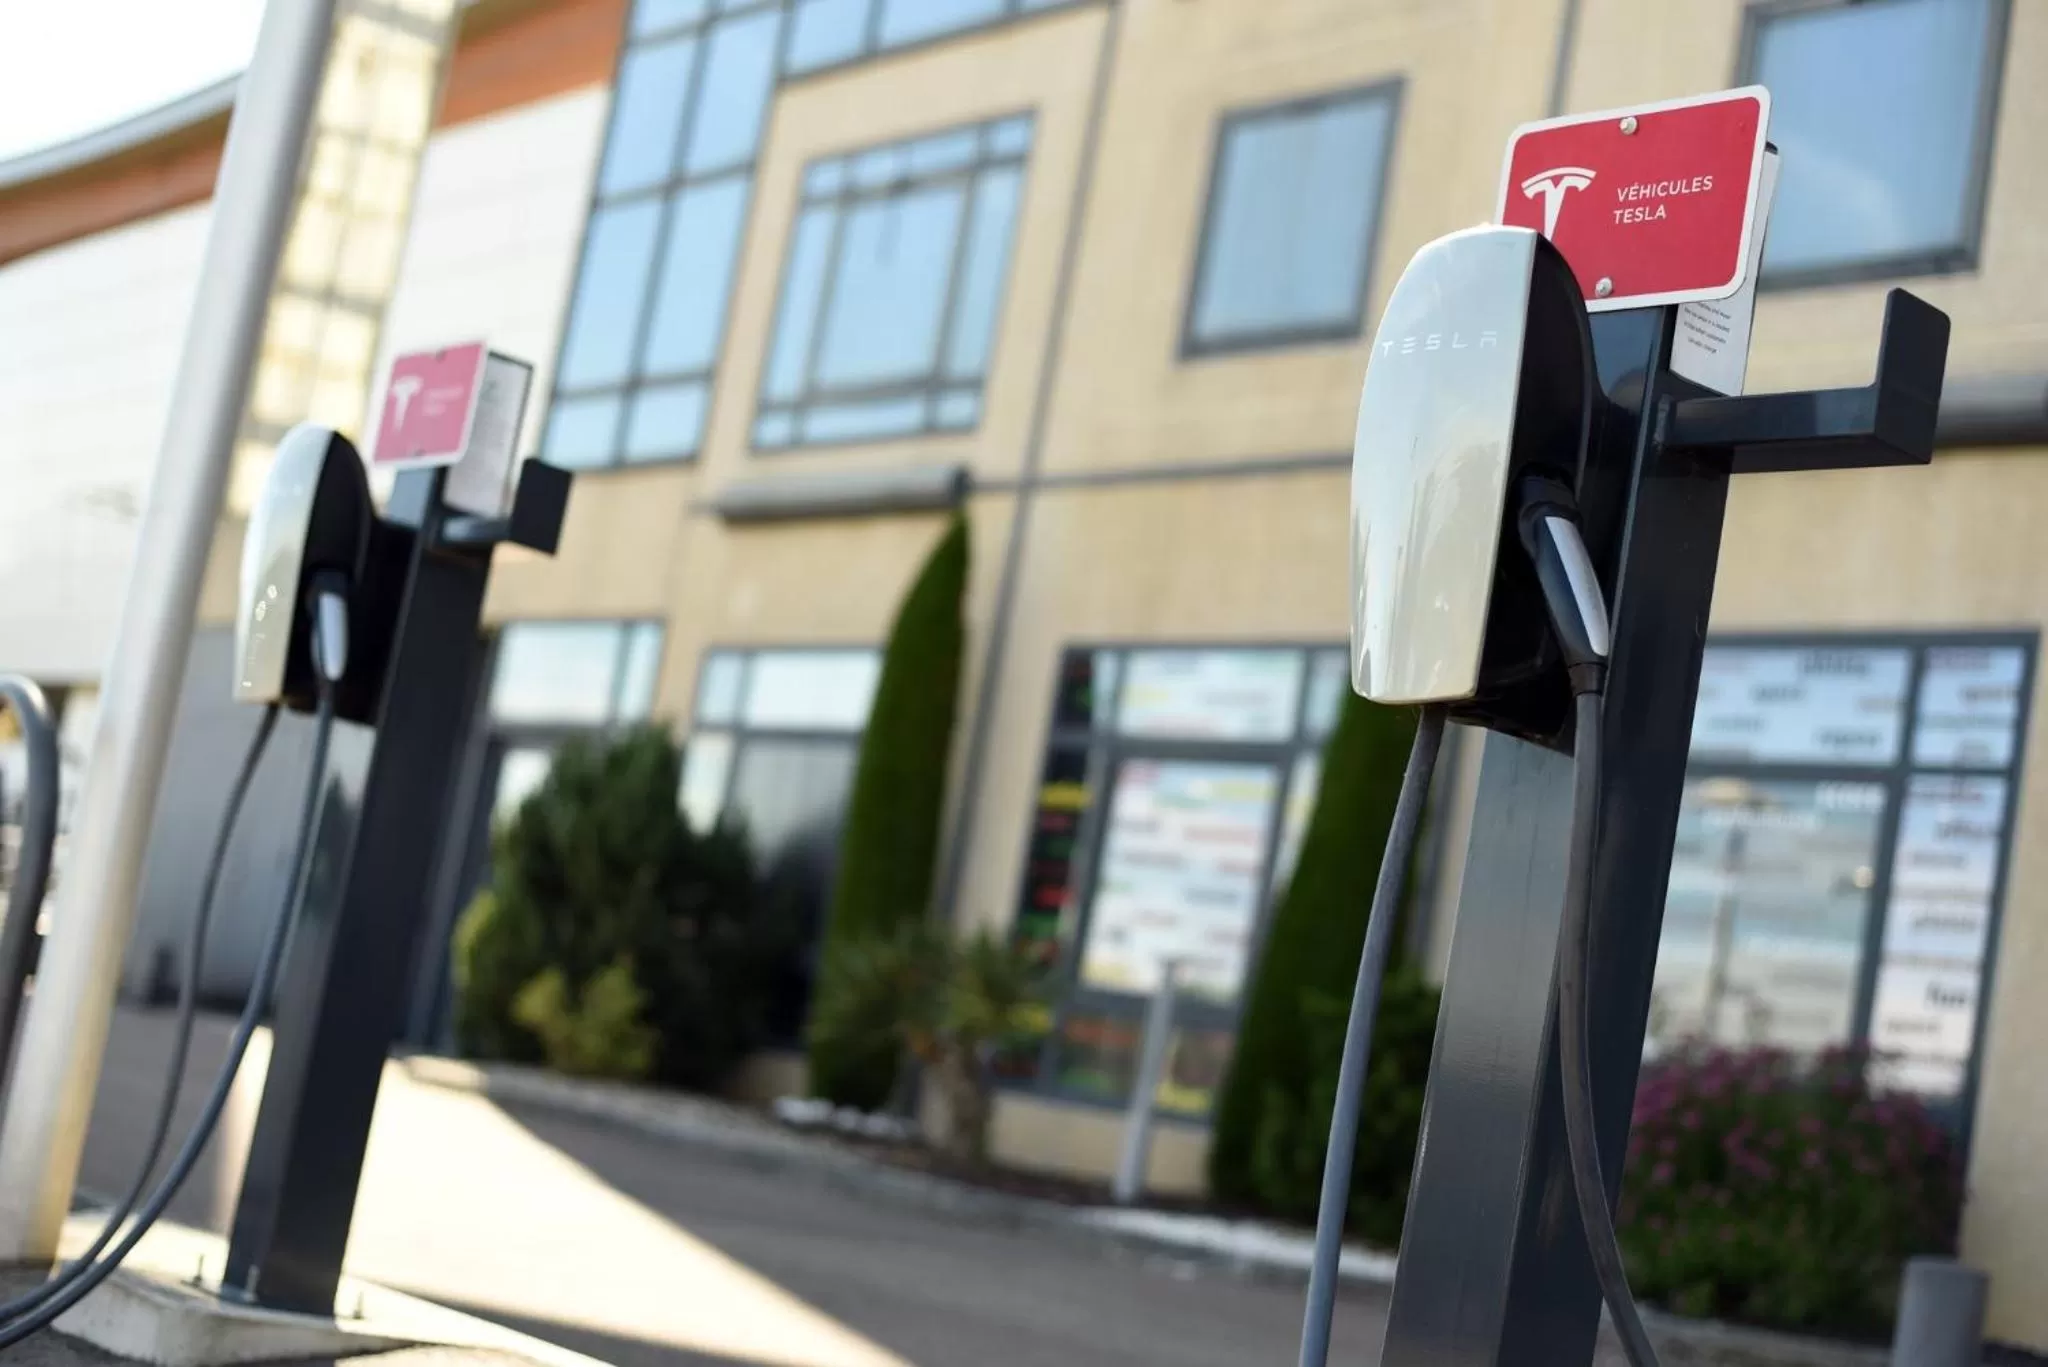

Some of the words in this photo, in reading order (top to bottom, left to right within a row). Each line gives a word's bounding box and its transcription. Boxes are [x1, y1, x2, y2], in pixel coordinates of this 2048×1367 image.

[1617, 175, 1713, 202] VÉHICULES
[1613, 204, 1666, 224] TESLA
[1381, 330, 1497, 358] TESLA
